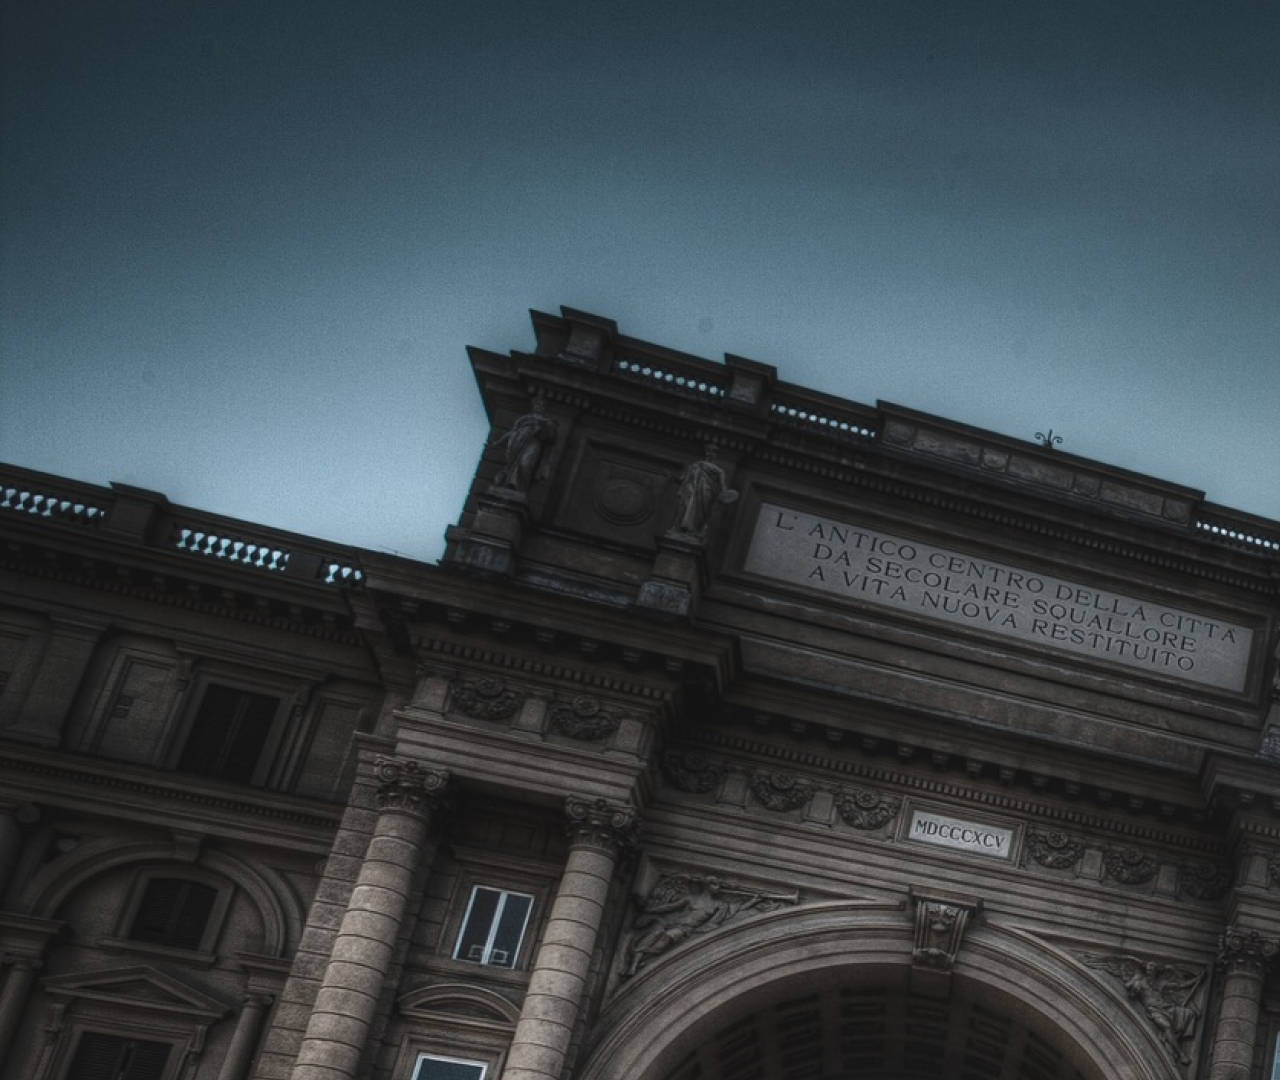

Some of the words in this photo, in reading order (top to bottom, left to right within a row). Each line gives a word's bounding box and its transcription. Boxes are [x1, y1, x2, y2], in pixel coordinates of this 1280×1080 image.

[808, 522, 917, 562] ANTICO
[928, 552, 1044, 594] CENTRO
[1055, 583, 1147, 622] DELLA
[808, 565, 825, 582] A
[843, 571, 907, 601] VITA
[921, 591, 1017, 629] NUOVA
[1032, 619, 1195, 672] RESTITUITO
[813, 543, 851, 567] DA
[865, 557, 1021, 609] SECOLARE
[1032, 599, 1197, 653] SQUALLORE
[914, 819, 1005, 849] MDCCCXCV
